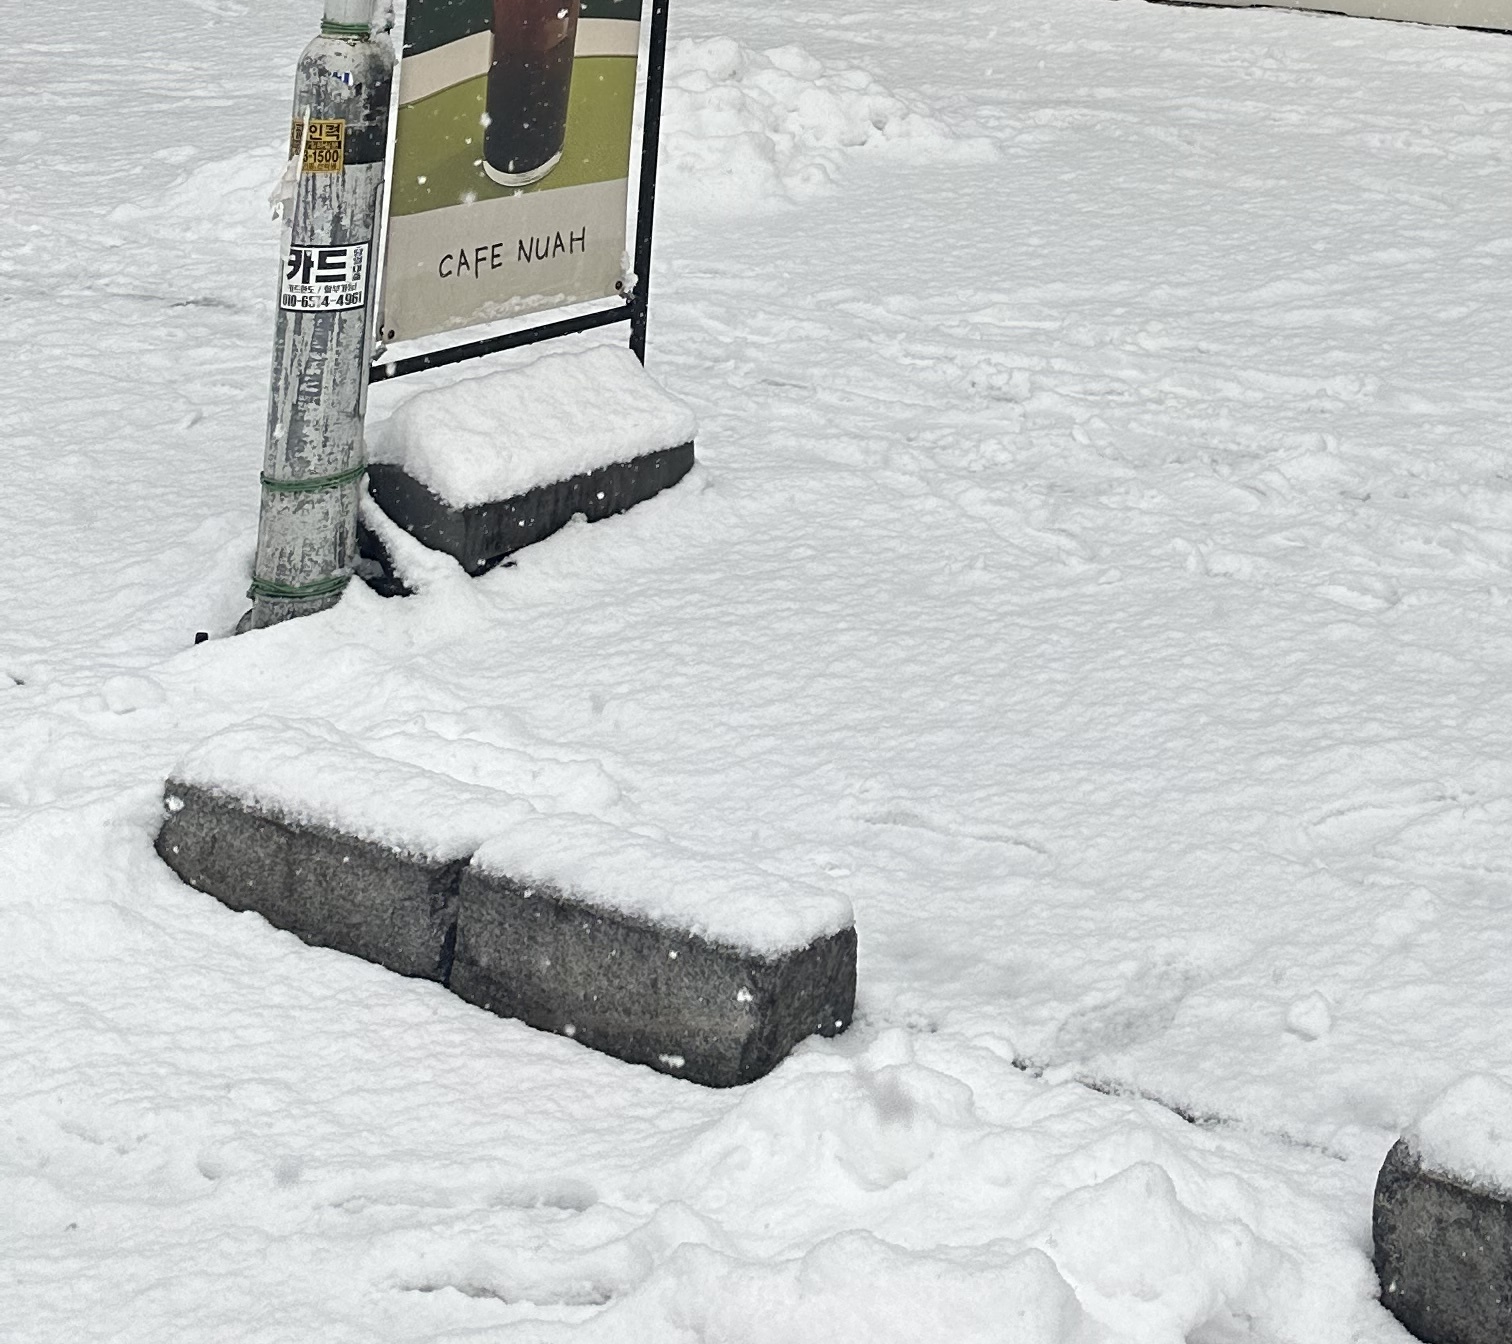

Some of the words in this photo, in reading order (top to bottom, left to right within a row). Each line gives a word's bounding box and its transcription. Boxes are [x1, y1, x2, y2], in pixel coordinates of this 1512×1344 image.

[286, 248, 348, 284] 카드
[439, 243, 503, 279] CAFE
[518, 226, 586, 263] NUAH
